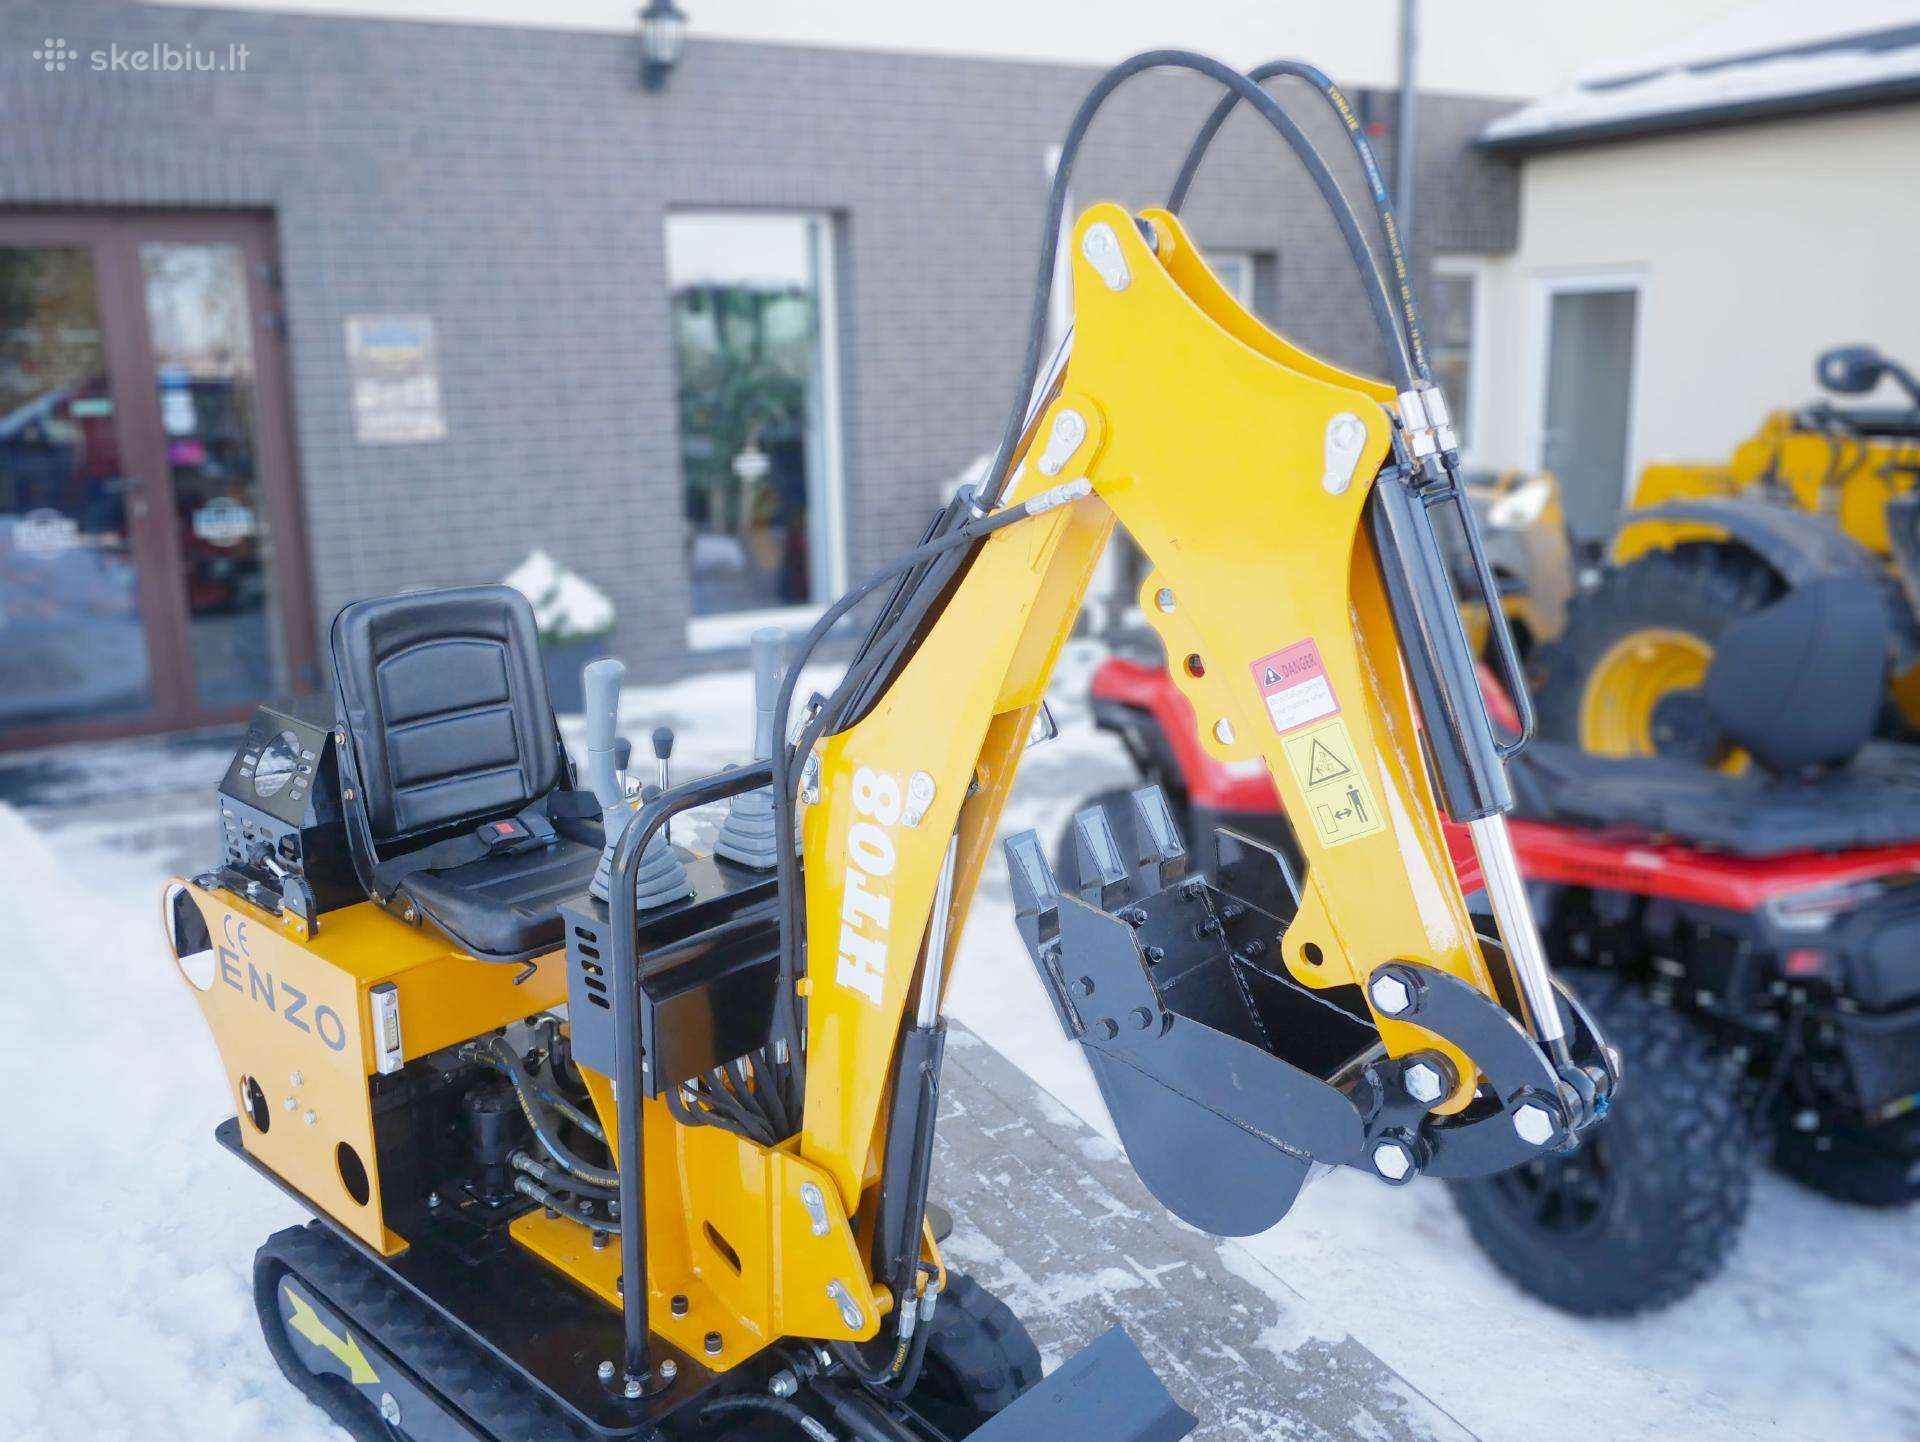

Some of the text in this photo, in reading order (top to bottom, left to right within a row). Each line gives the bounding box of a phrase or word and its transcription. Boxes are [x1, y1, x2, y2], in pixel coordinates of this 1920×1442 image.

[1282, 653, 1317, 678] DANGER
[836, 766, 901, 1006] HT08
[218, 945, 346, 1051] ENZO
